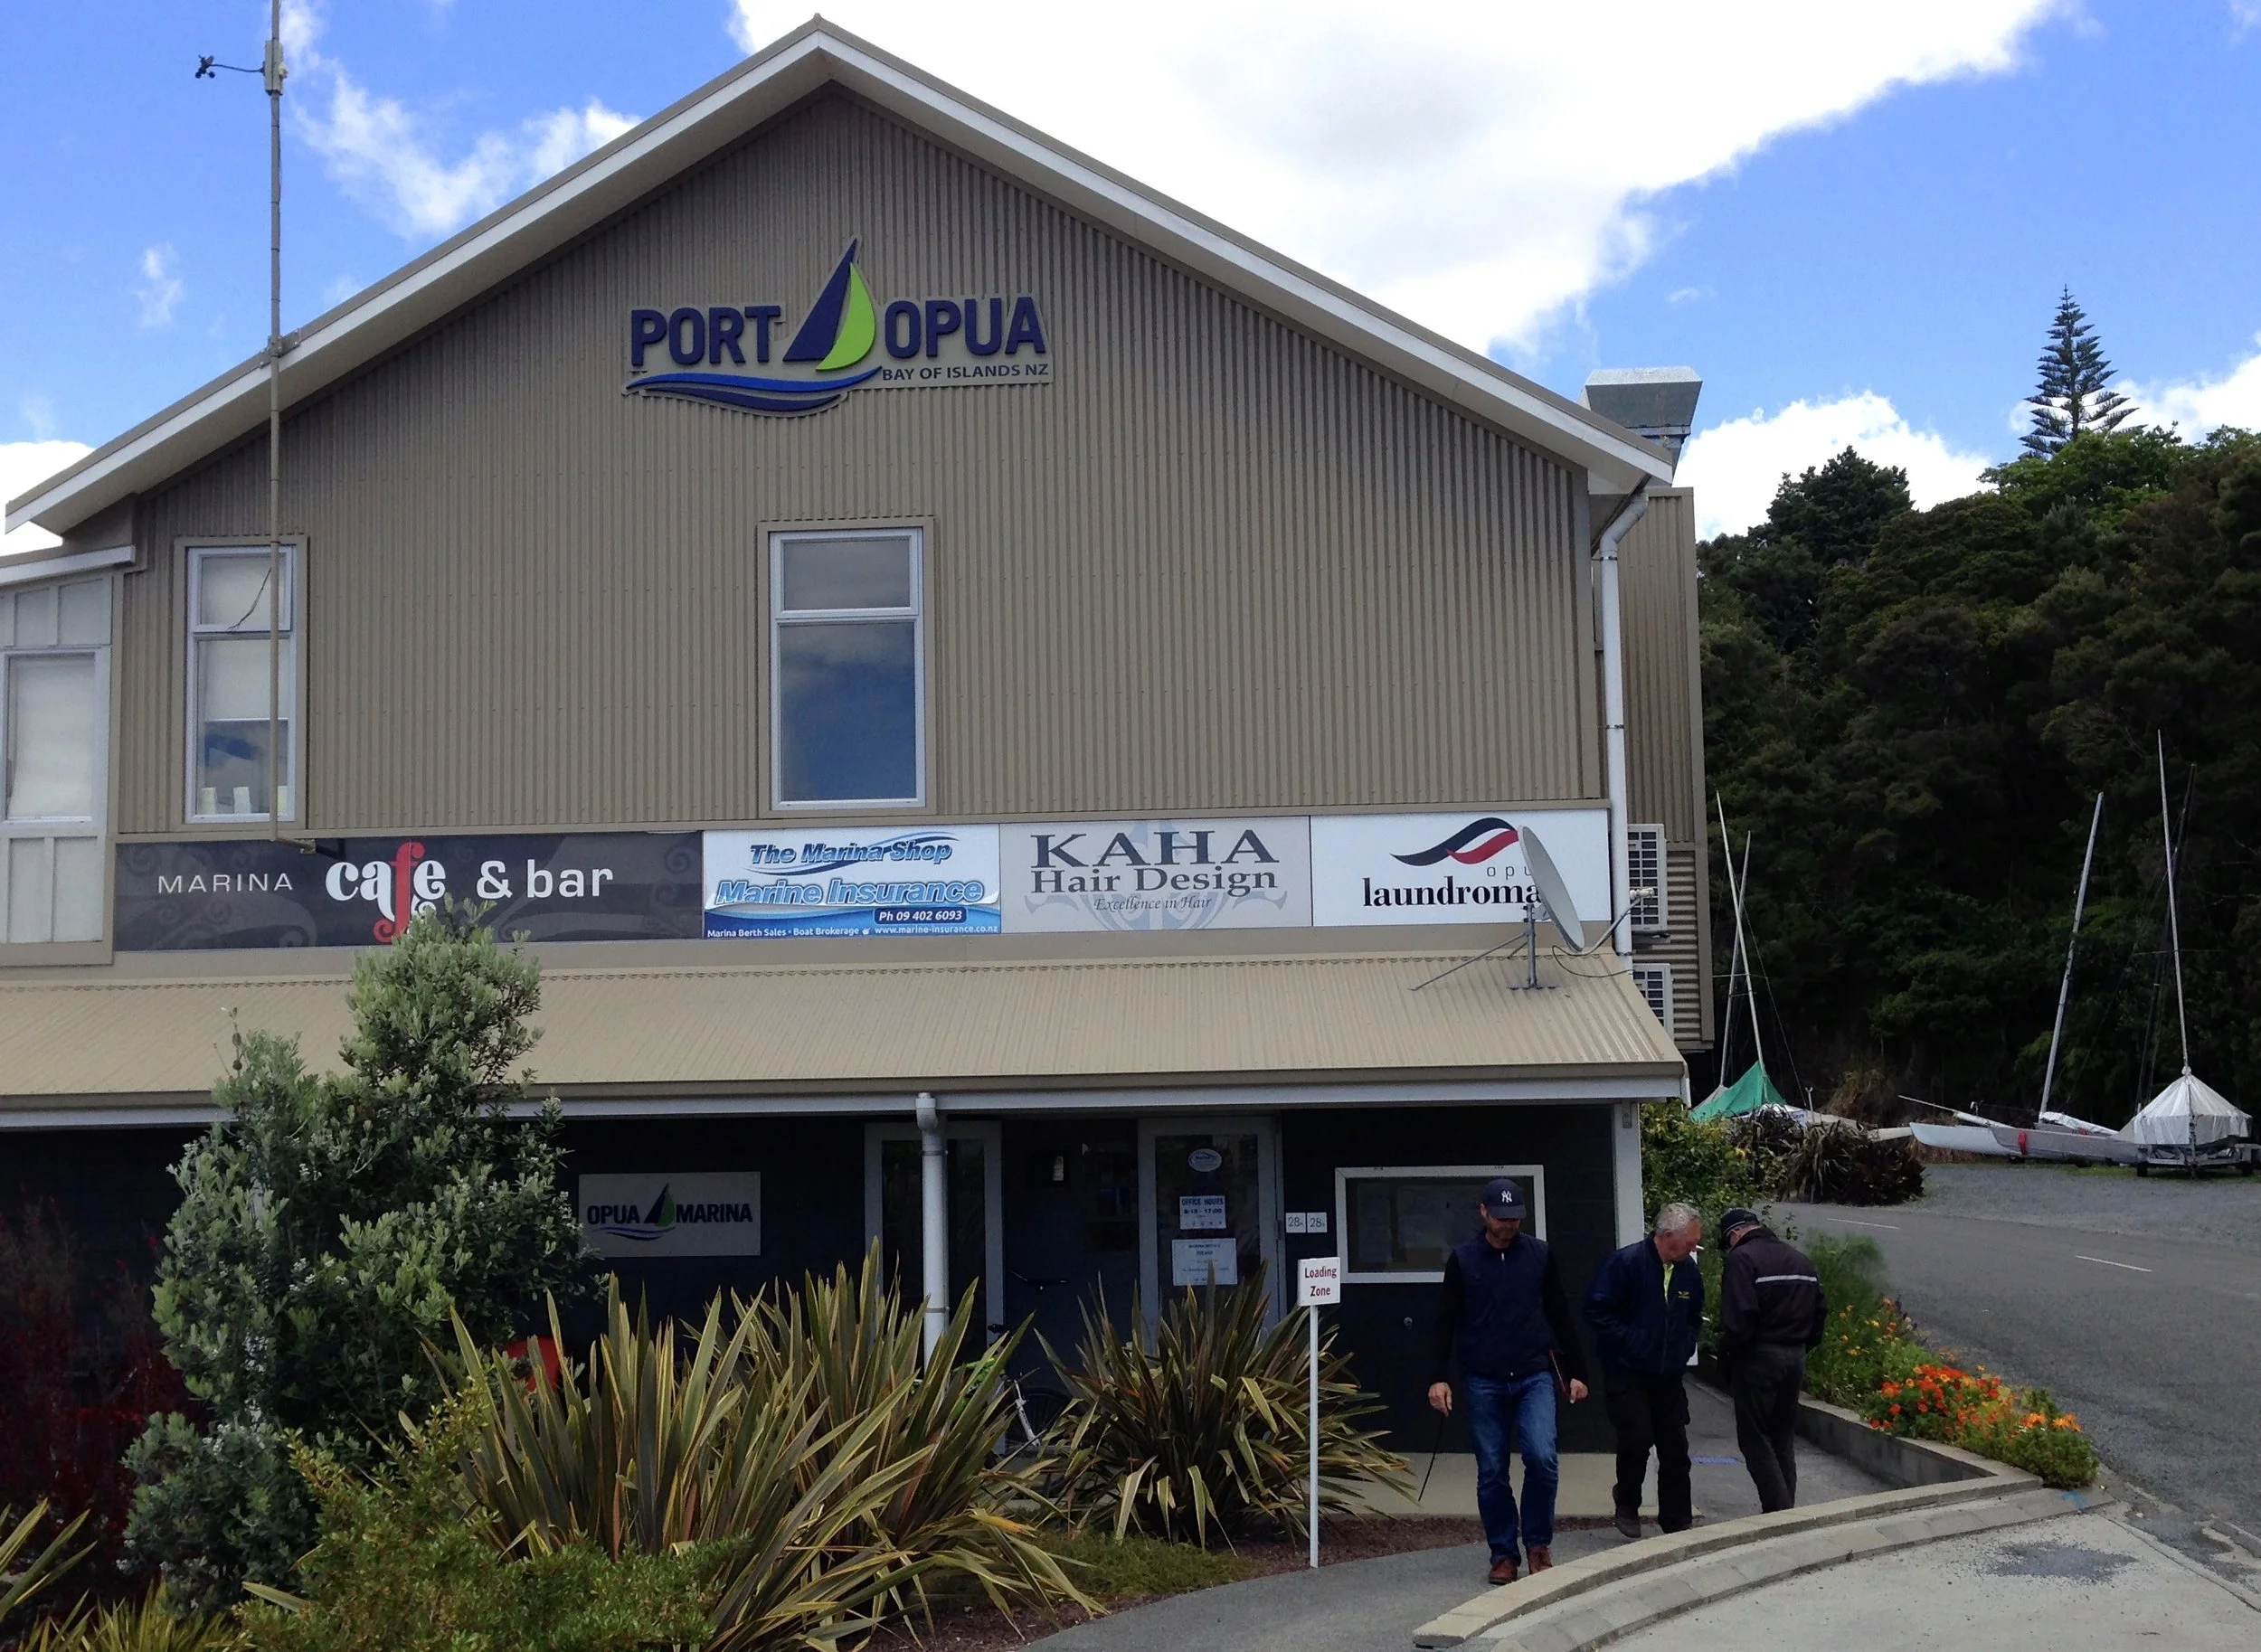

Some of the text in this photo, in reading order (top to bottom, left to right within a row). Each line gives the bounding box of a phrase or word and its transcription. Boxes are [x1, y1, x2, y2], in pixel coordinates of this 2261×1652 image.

[630, 296, 1047, 367] PORT OPUA
[883, 363, 1050, 382] BAY OF ISLANDS NZ
[750, 840, 953, 864] The Marina Shop
[1030, 829, 1280, 868] KAHA
[157, 873, 294, 894] MARINA
[476, 860, 513, 899] &
[526, 859, 615, 899] bar
[1031, 865, 1278, 897] Hair Design
[1486, 865, 1532, 881] opu
[714, 877, 985, 905] Marine Insurance
[1362, 875, 1542, 906] laundroma
[1093, 895, 1213, 911] Excellence in Hair
[879, 910, 962, 921] Ph 09 402 6093
[707, 924, 998, 938] Marina Berth Sales Boat Brokerage www.marine-insurance.co.nz
[1181, 1198, 1202, 1206] OFFICE
[1501, 1190, 1512, 1204] NY
[587, 1203, 753, 1225] OPUA MARINA
[1304, 1267, 1337, 1279] Loading
[1310, 1286, 1330, 1297] Zone
